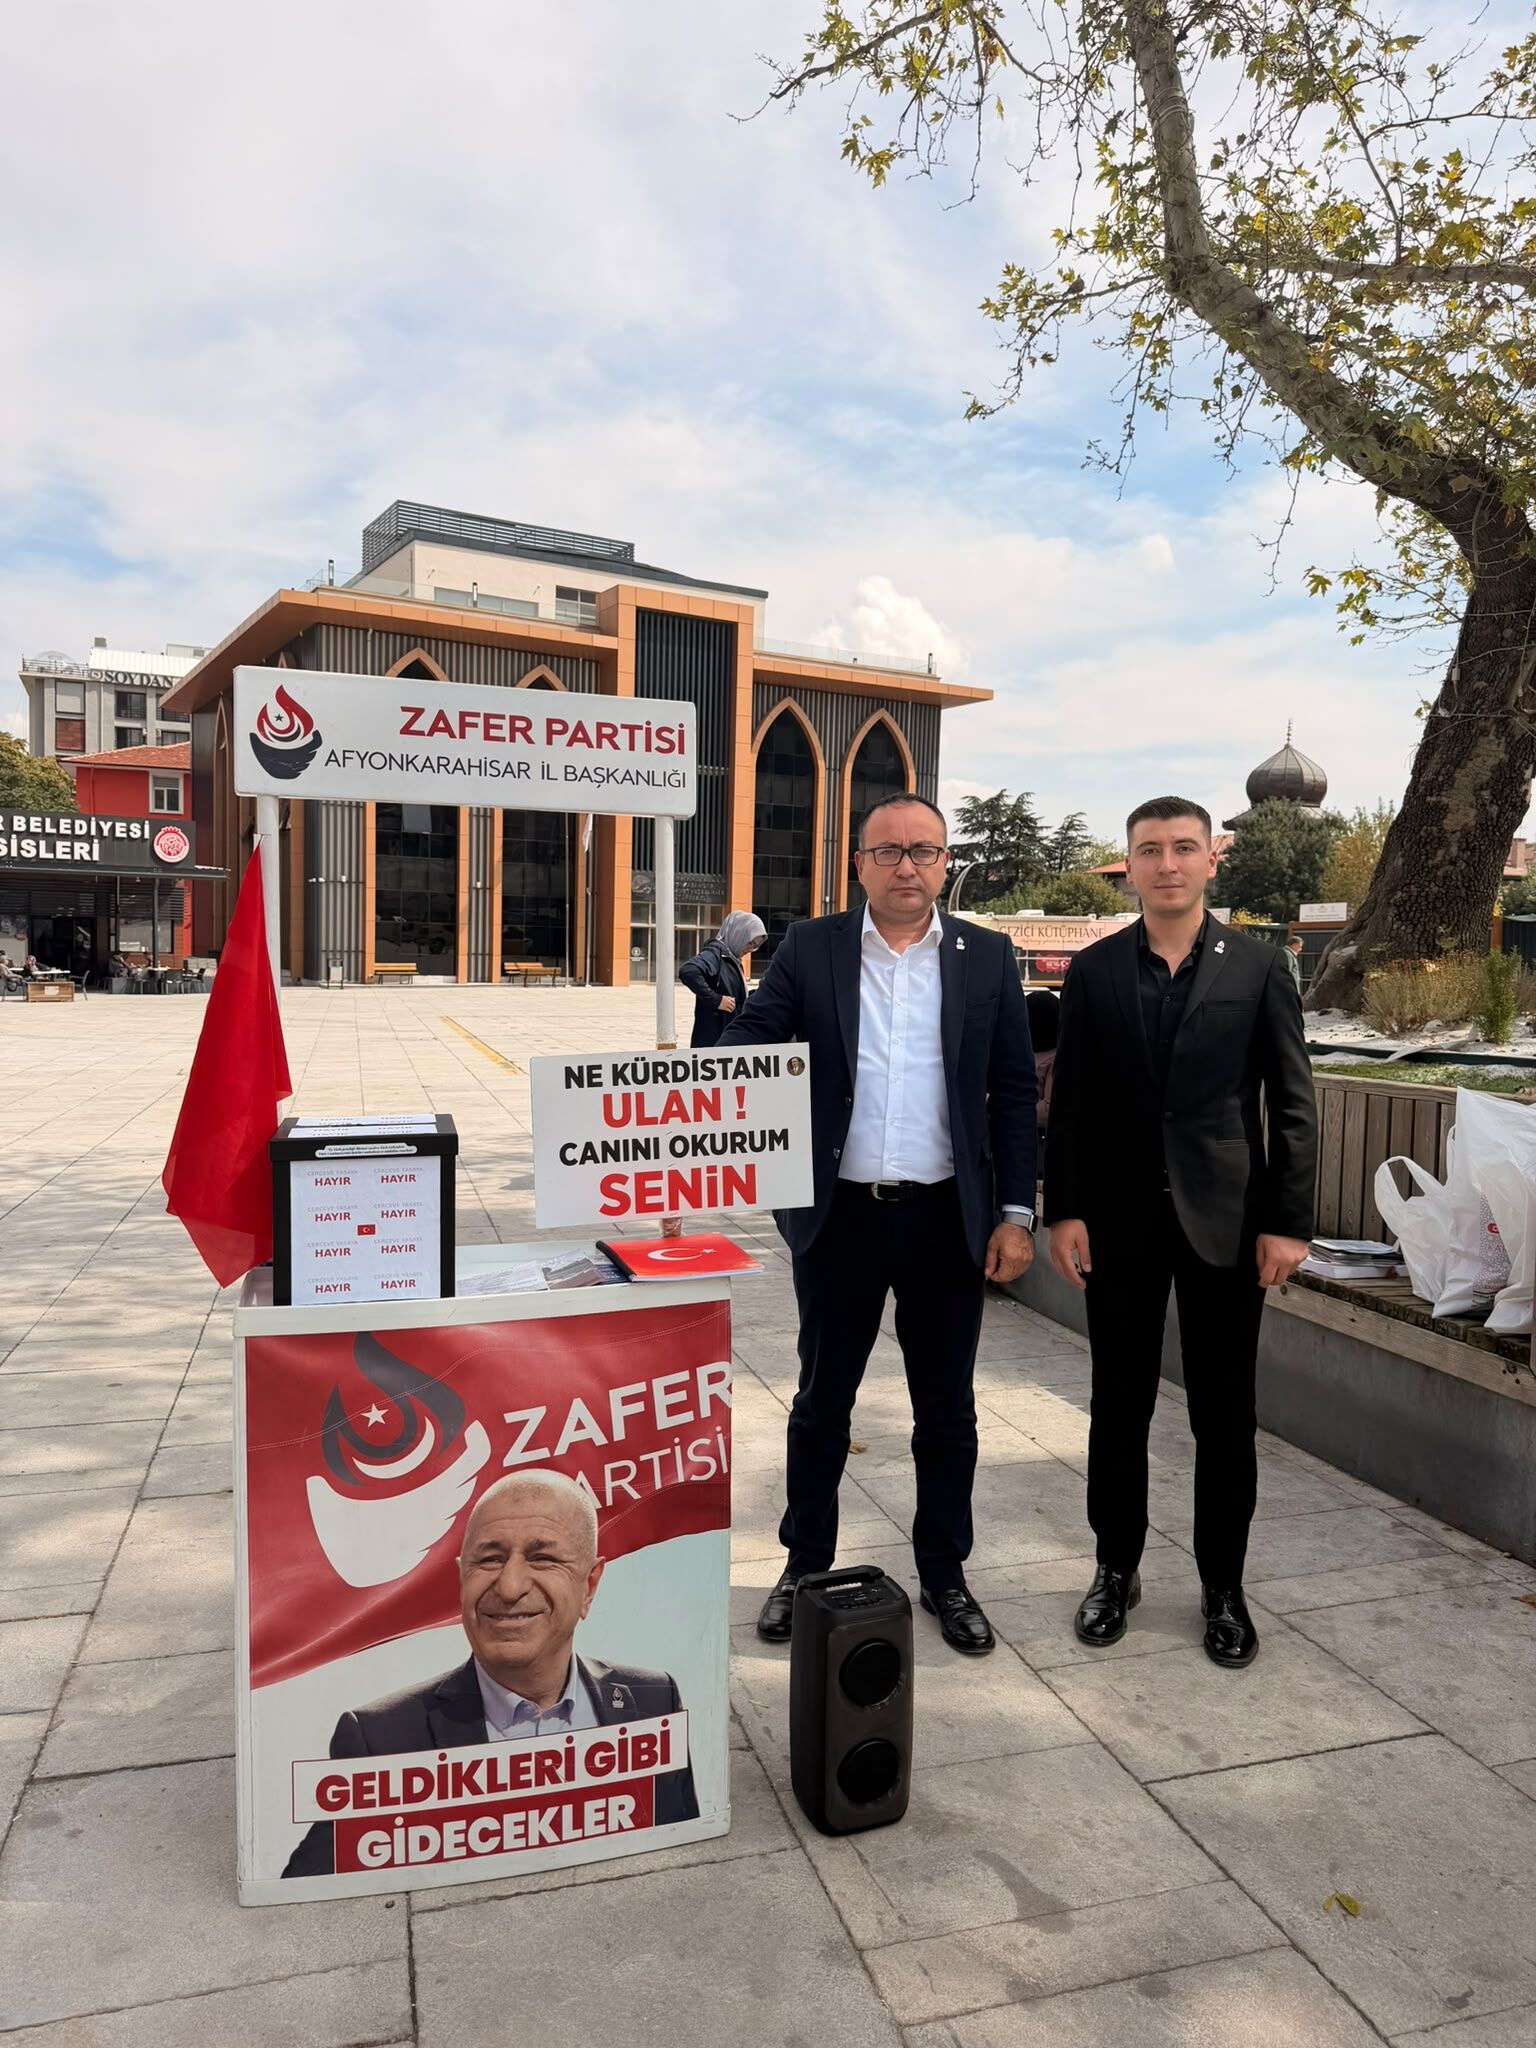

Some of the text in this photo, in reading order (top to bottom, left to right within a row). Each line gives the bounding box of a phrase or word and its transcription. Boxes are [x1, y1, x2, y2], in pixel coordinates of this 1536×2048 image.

[105, 670, 173, 689] SOYDAN
[400, 706, 686, 756] ZAFER PARTİSİ
[324, 748, 687, 789] AFYONKARAHİSAR İL BAŞKANLIĞI
[13, 815, 150, 840] BELEDİYESİ
[1038, 924, 1104, 938] KÜTÜPHANE
[564, 1054, 780, 1089] NE KÜRDİSTANI
[602, 1086, 746, 1129] ULAN !
[559, 1128, 789, 1166] CANINI OKURUM
[314, 1176, 351, 1187] HAYIR
[380, 1174, 416, 1184] HAYIR
[598, 1163, 757, 1217] SENİN
[314, 1212, 351, 1222] HAYIR
[380, 1209, 416, 1219] HAYIR
[314, 1247, 351, 1257] HAYIR
[380, 1244, 416, 1254] HAYIR
[314, 1283, 351, 1293] HAYIR
[380, 1279, 416, 1289] HAYIR
[502, 1361, 732, 1468] ZAFER
[574, 1426, 729, 1510] ARTİSİ
[315, 1718, 671, 1813] GELDİKLERİ GİBİ
[356, 1794, 637, 1868] GİDECEKLER
